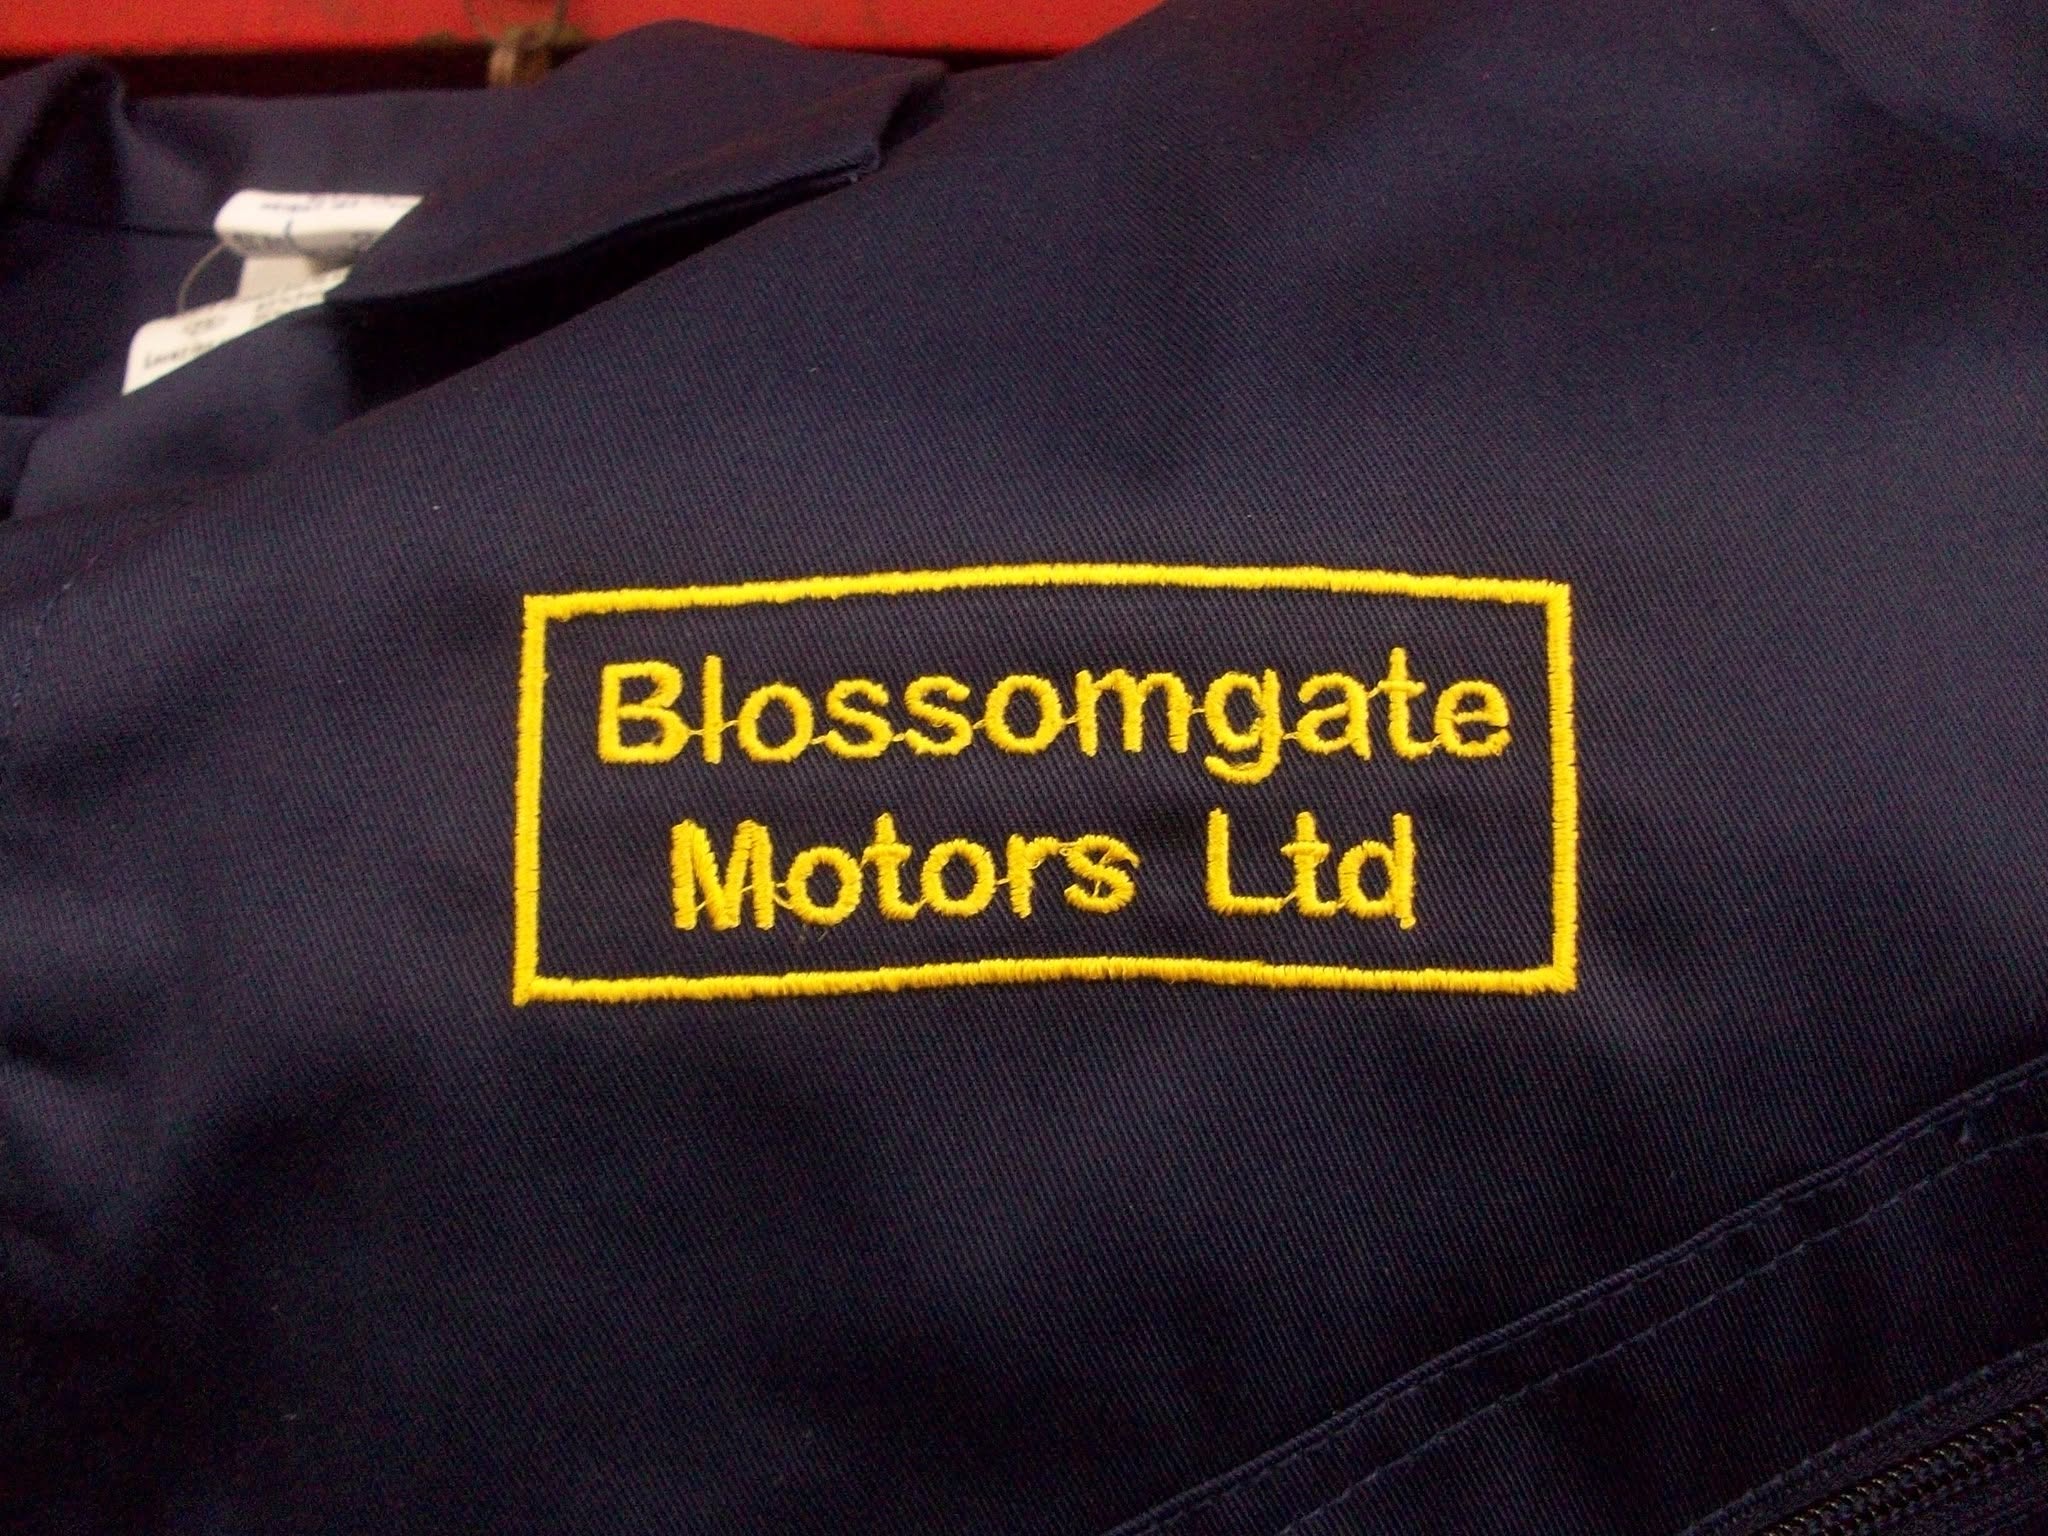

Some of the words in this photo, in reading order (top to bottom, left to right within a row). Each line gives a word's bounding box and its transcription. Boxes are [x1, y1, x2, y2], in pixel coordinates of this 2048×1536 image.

[598, 647, 1512, 784] Blossomgate
[671, 813, 1140, 930] Motors
[1206, 808, 1416, 930] Ltd
